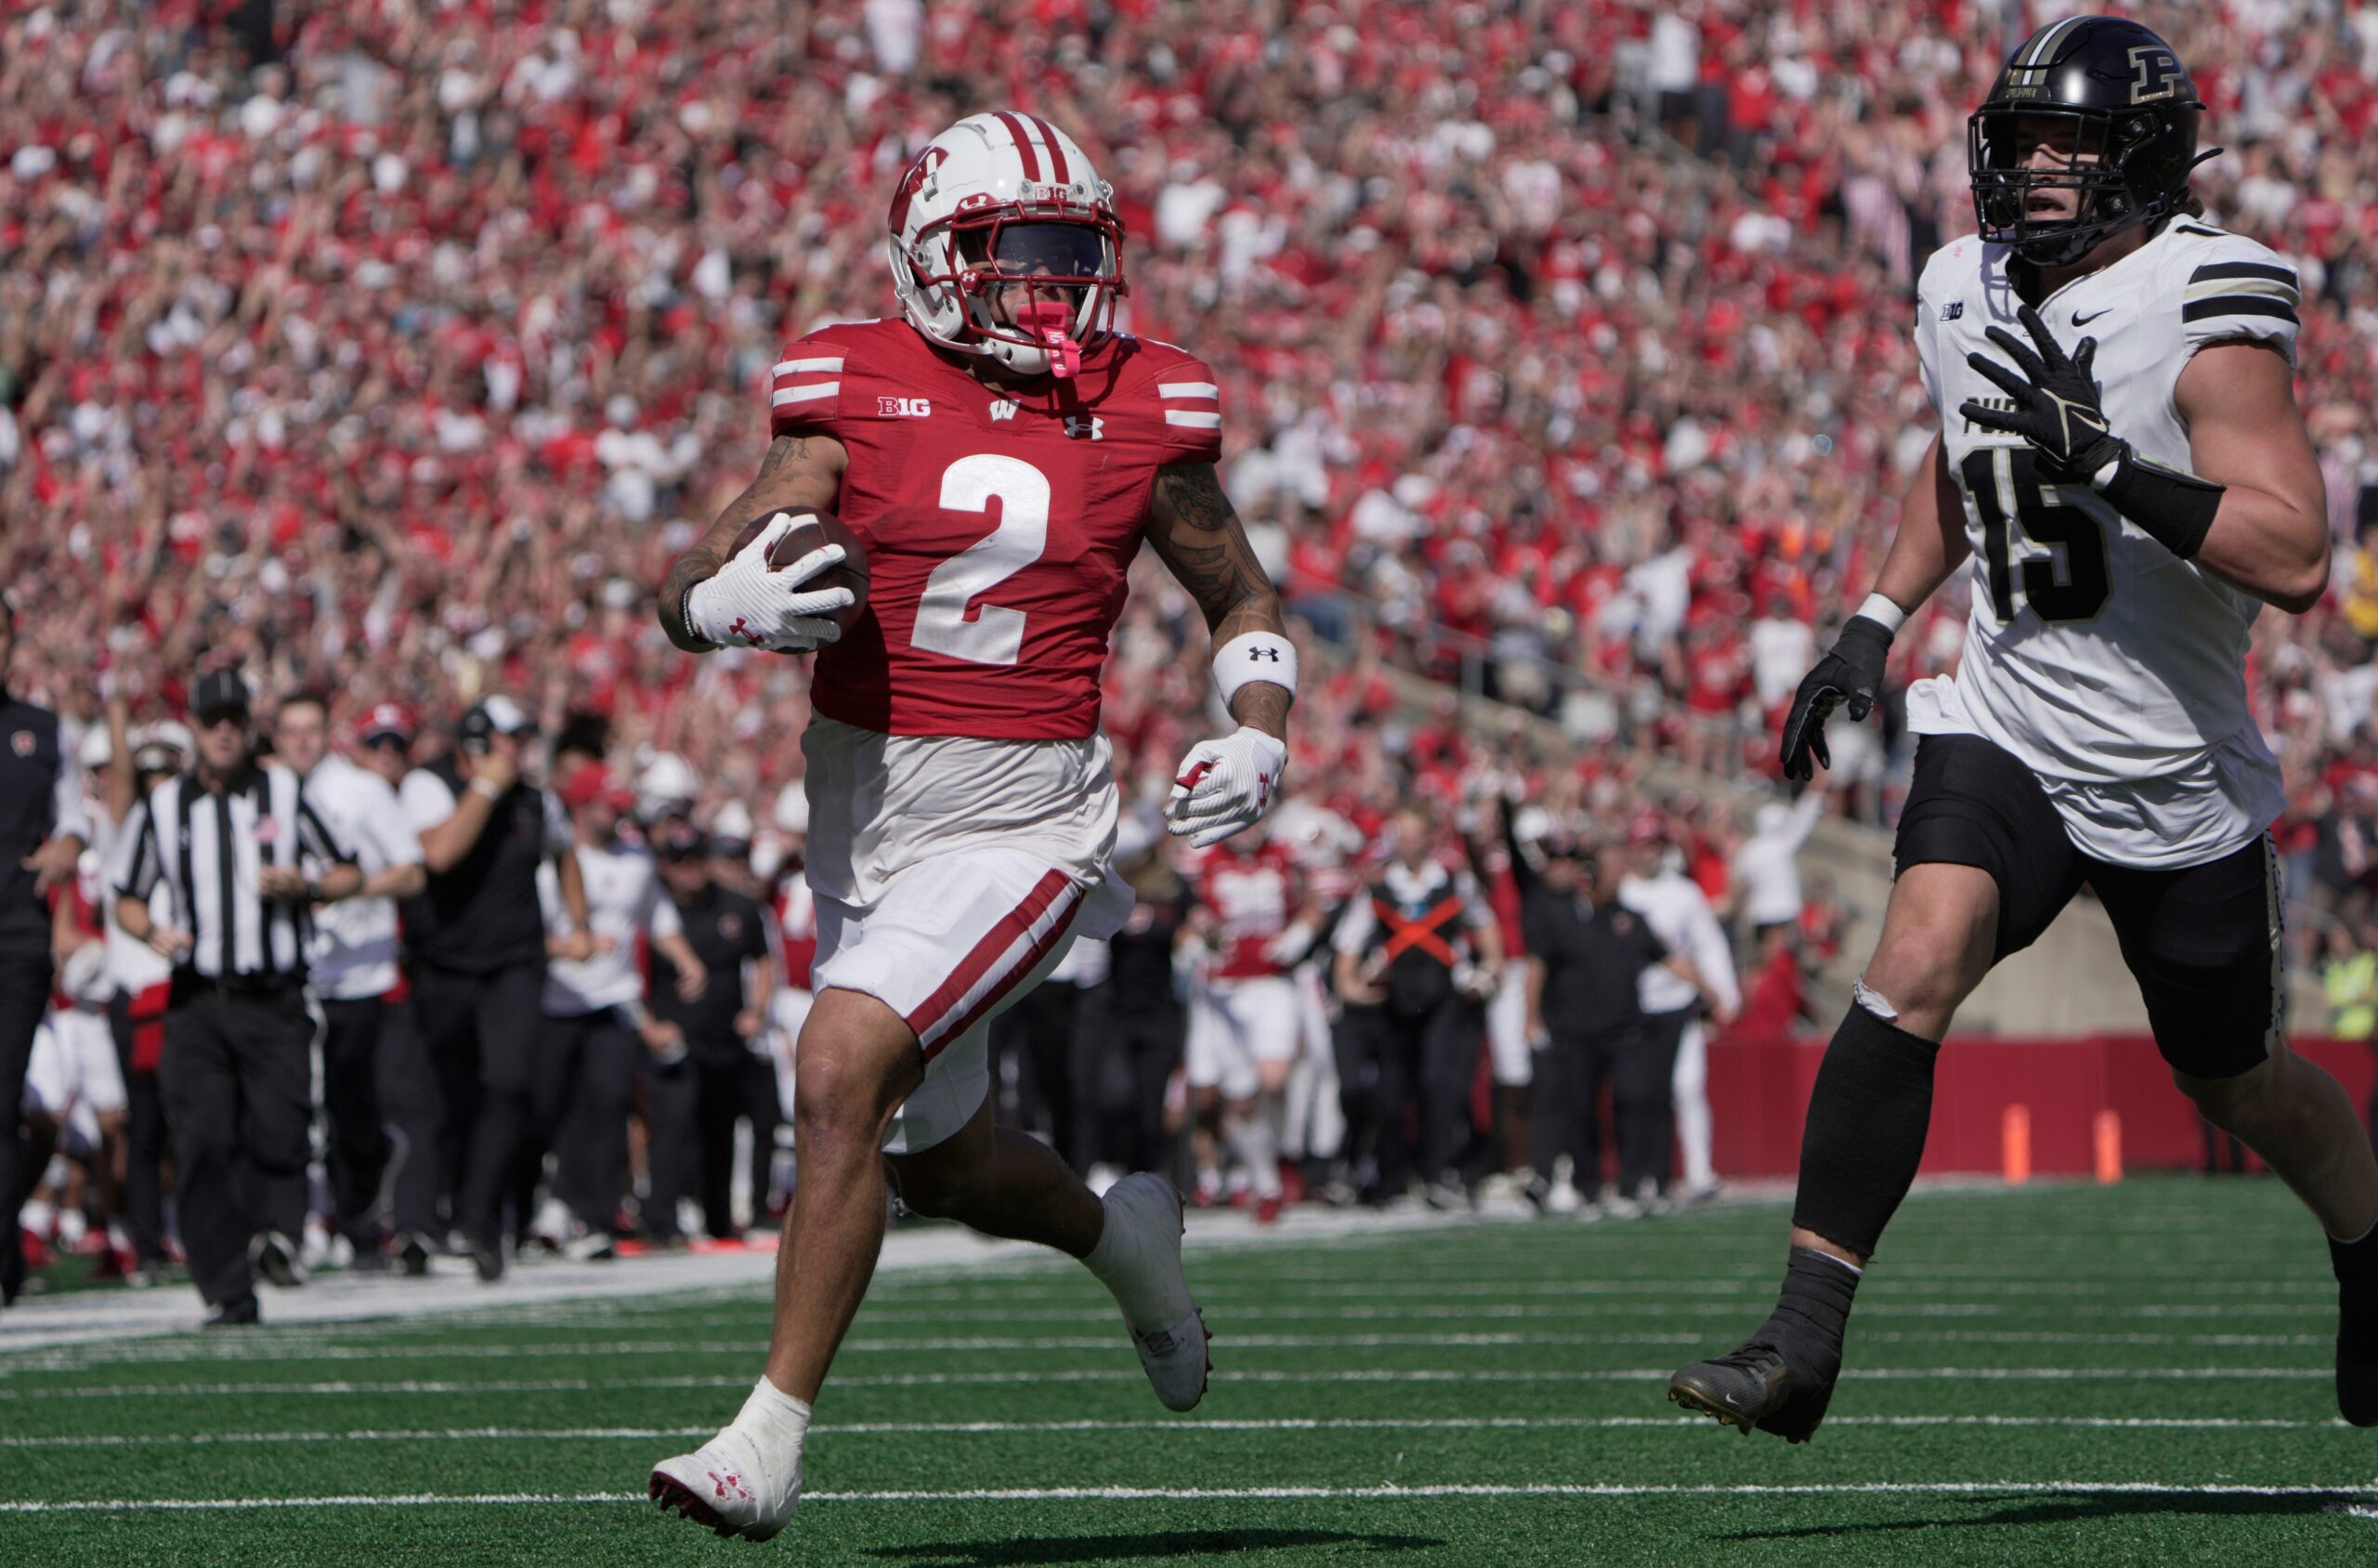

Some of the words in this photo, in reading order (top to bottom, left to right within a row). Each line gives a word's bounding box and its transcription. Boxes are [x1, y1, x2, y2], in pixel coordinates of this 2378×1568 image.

[2127, 46, 2184, 105] P
[989, 399, 1021, 423] W
[910, 453, 1051, 665] 2
[1959, 445, 2114, 626] 15
